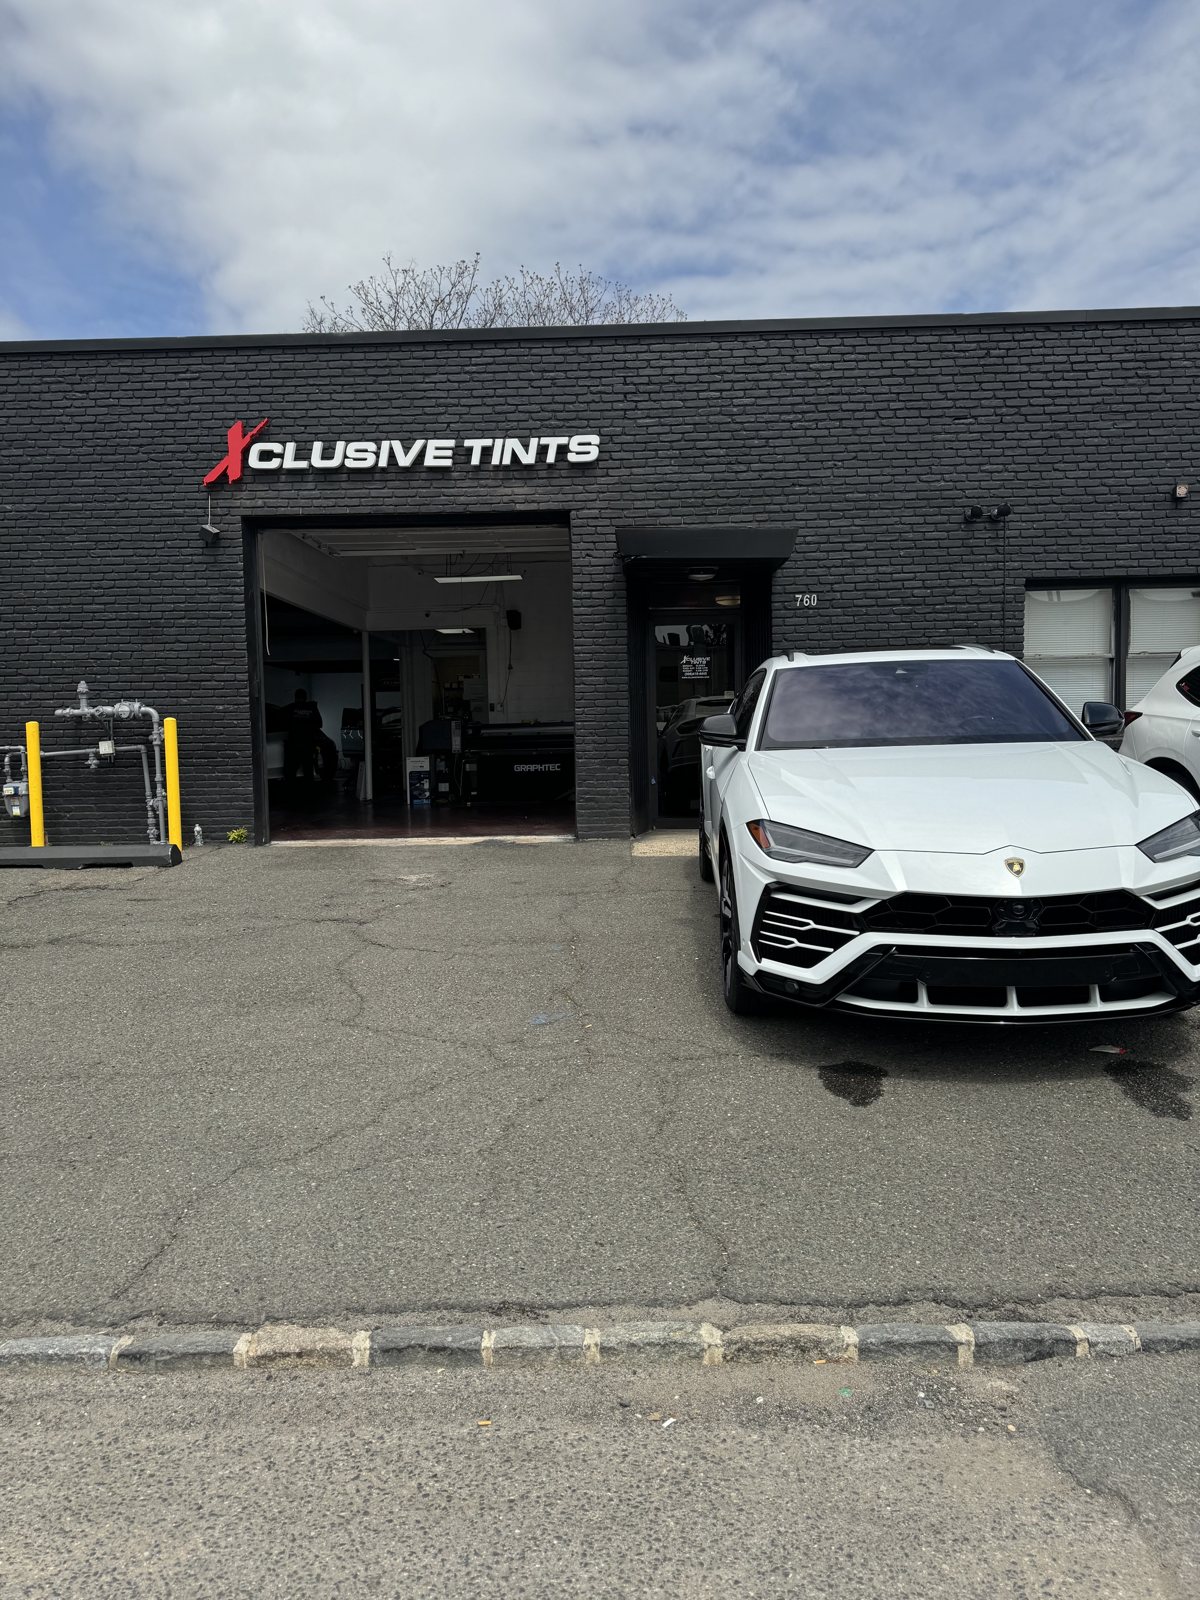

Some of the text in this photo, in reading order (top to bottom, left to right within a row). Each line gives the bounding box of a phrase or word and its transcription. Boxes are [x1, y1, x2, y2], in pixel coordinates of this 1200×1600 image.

[203, 417, 600, 487] XCLUSIVE TINTS
[795, 594, 817, 607] 760
[514, 763, 561, 772] GRAPHTEC
